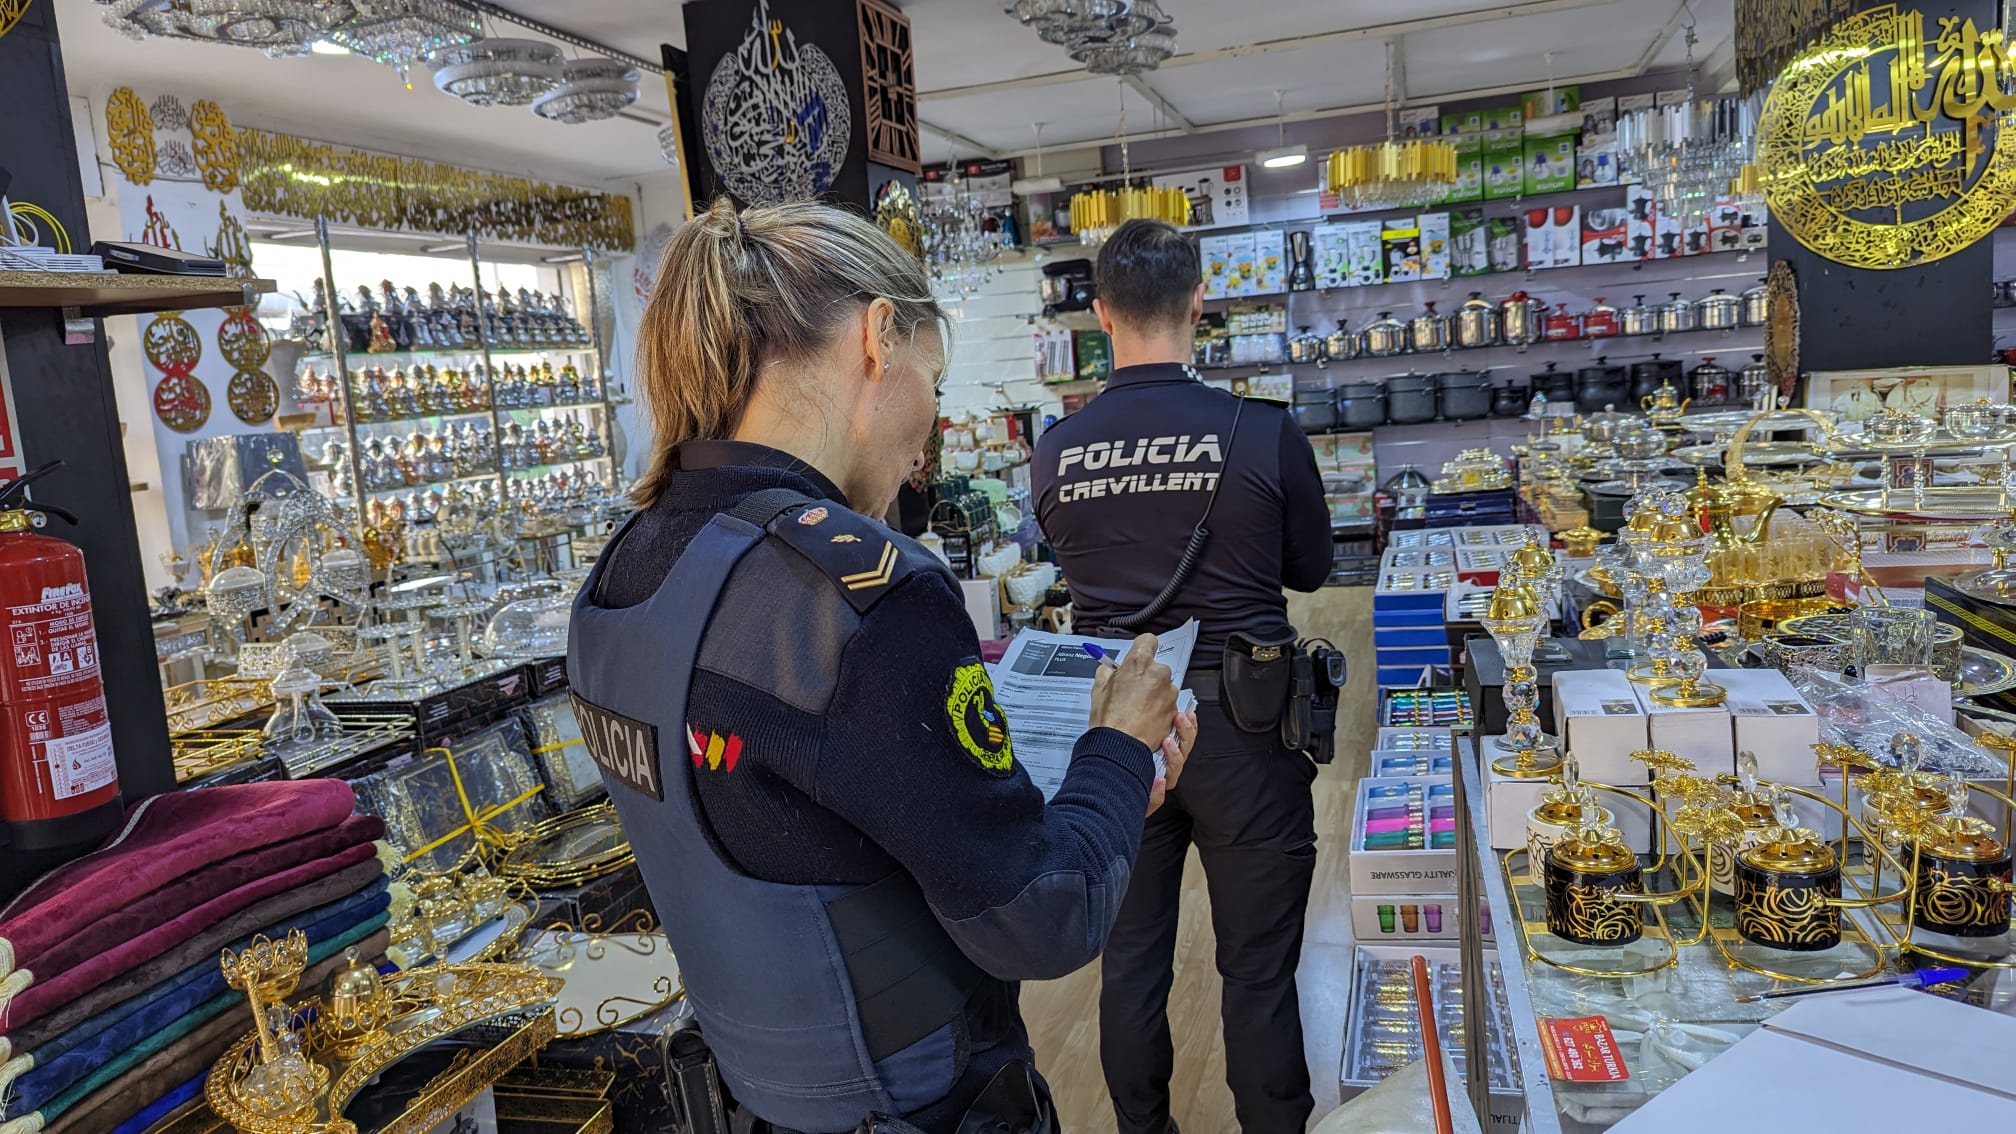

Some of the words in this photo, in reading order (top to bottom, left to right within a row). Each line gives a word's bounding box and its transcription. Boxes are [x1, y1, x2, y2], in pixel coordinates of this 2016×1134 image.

[1057, 434, 1222, 476] POLICIA
[1058, 472, 1222, 503] CREVILLENT
[12, 602, 58, 616] EXTINTOR
[1370, 870, 1422, 880] GLASSWARE
[1423, 869, 1456, 880] UALITY
[1593, 1033, 1611, 1055] BAZAR
[1603, 1055, 1622, 1080] TURKIA
